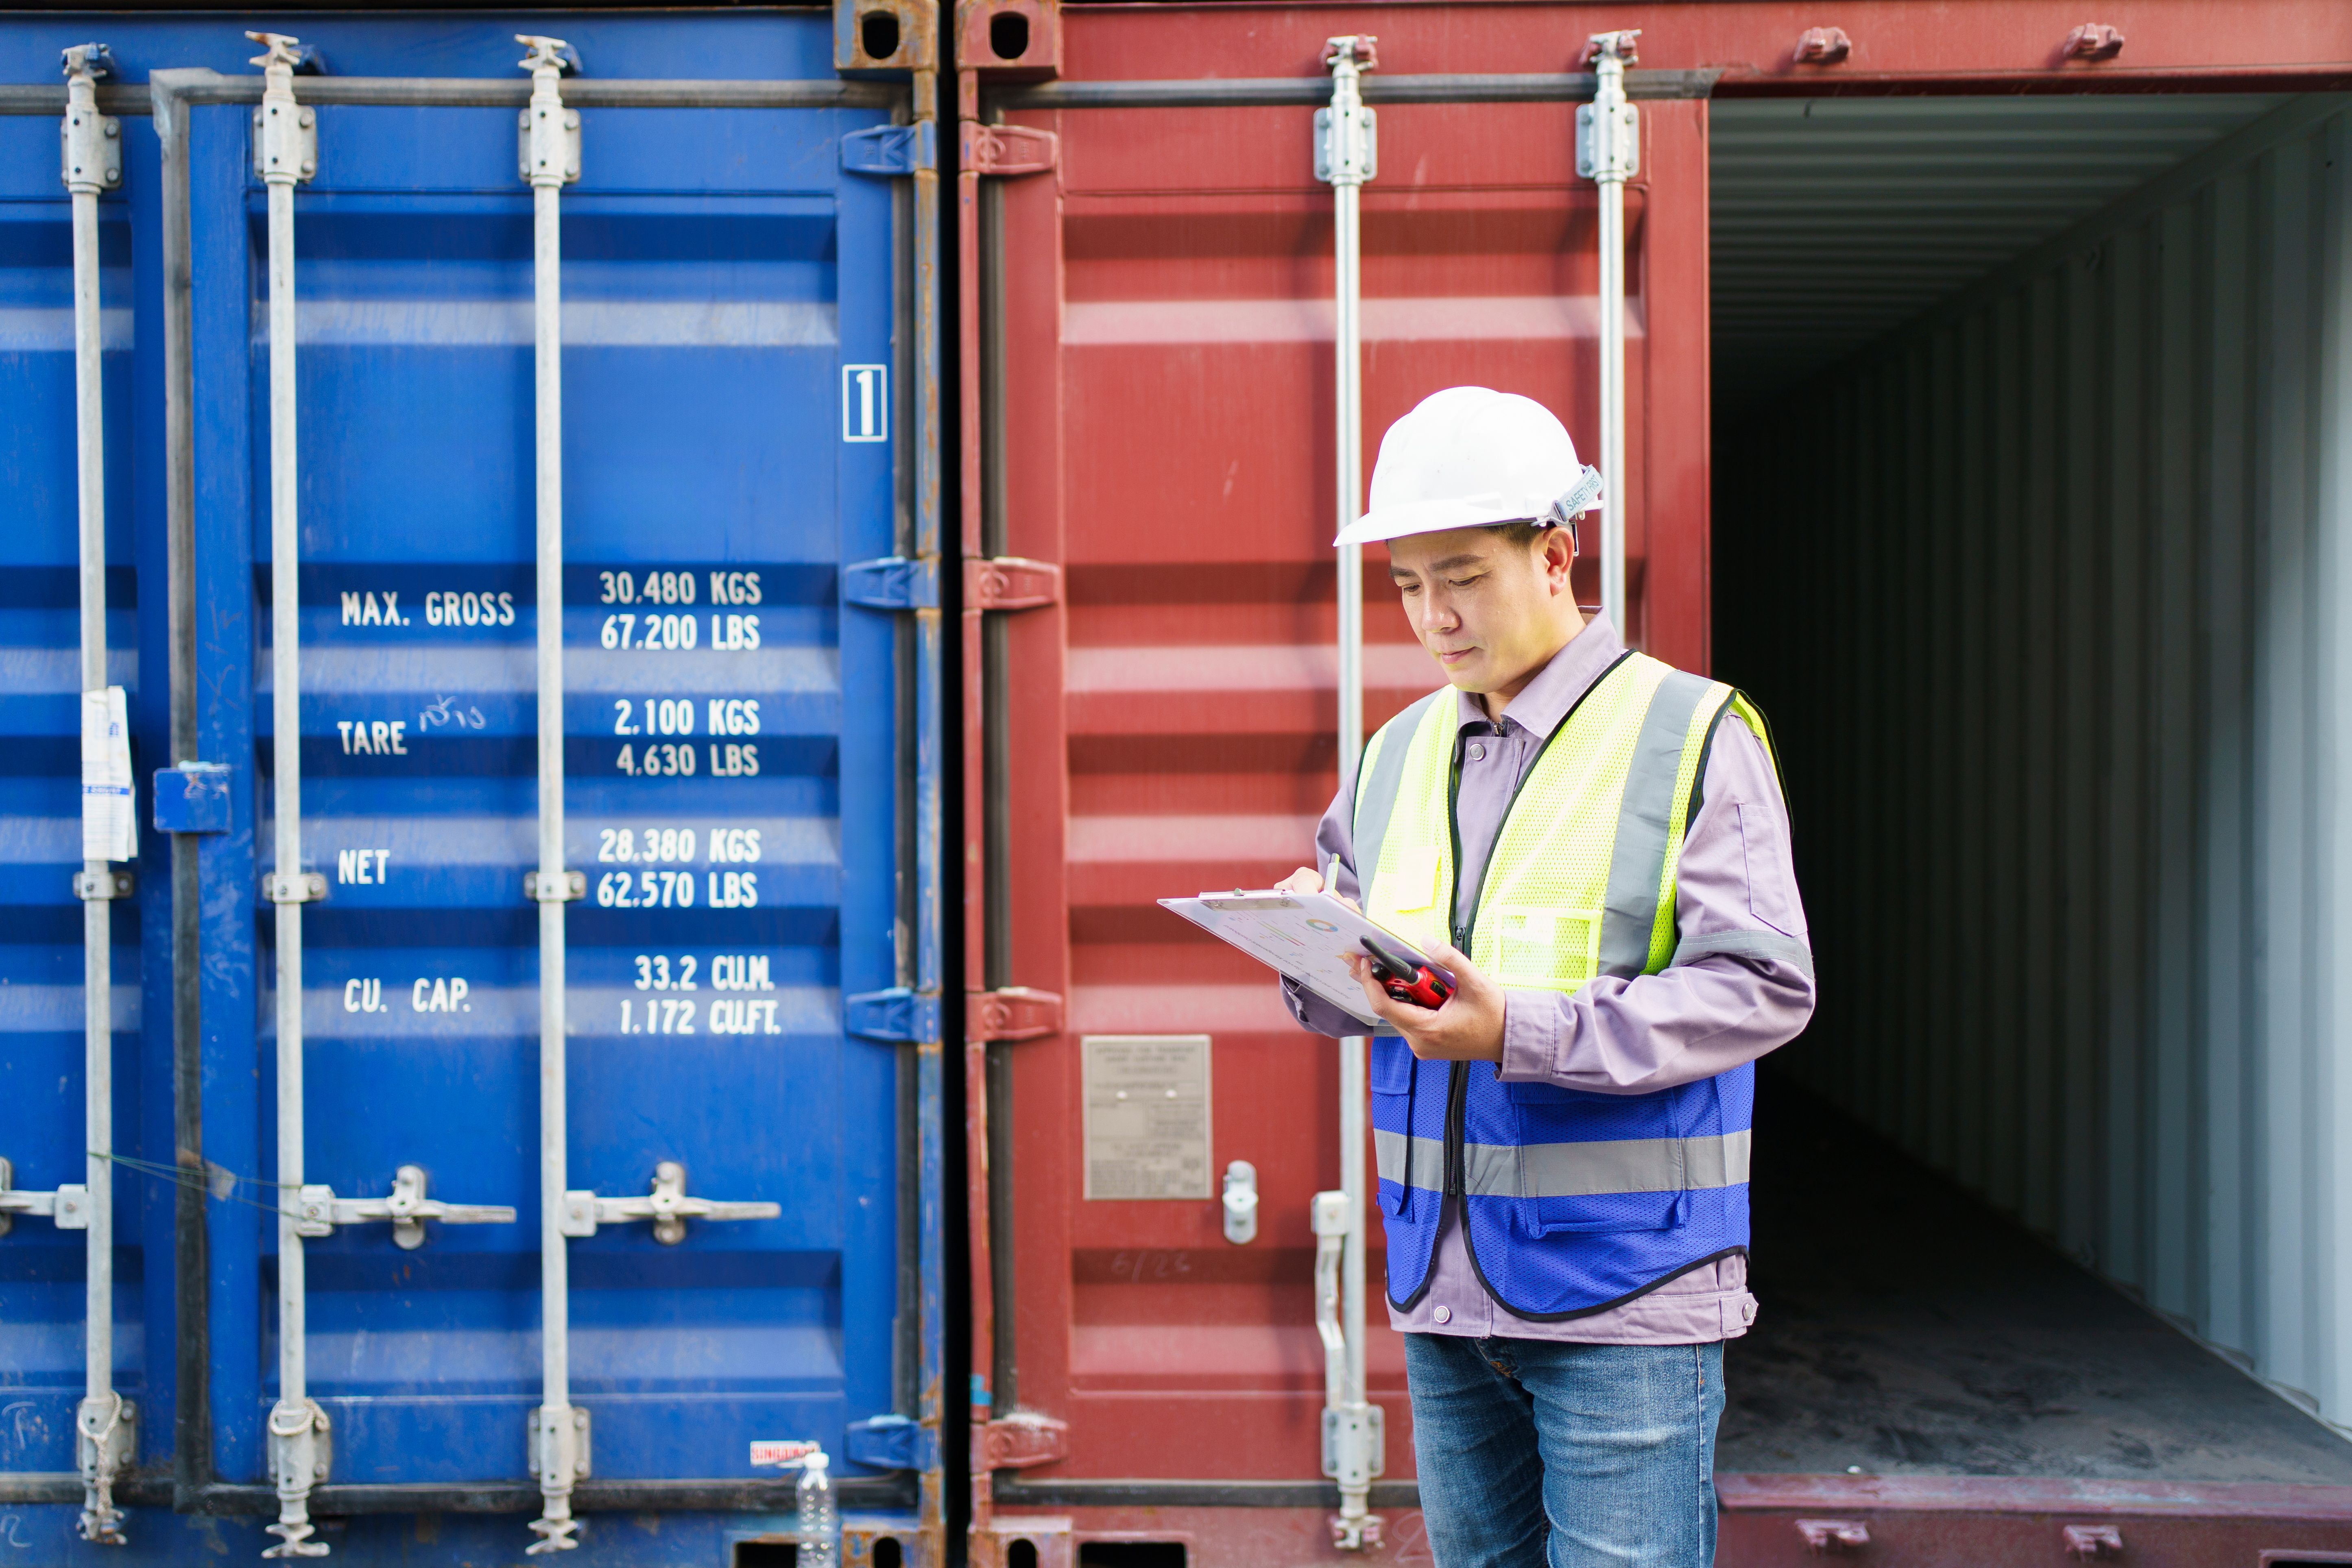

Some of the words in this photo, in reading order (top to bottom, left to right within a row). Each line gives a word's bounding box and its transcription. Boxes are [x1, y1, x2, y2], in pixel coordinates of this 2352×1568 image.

[856, 370, 873, 436] 1
[1566, 485, 1590, 511] SAFETY
[1586, 474, 1599, 492] FIRST
[711, 572, 761, 604] KGS
[341, 592, 409, 626] MAX.
[425, 592, 514, 626] GROSS
[712, 614, 760, 649] LBS
[709, 699, 759, 736] KGS
[338, 721, 407, 754] TARE
[711, 744, 759, 776] LBS
[709, 828, 761, 863] KGS
[338, 849, 391, 884] NET
[709, 872, 757, 908] LBS
[635, 955, 696, 990] 33.2
[344, 978, 388, 1013] CU.
[412, 977, 471, 1013] CAP.
